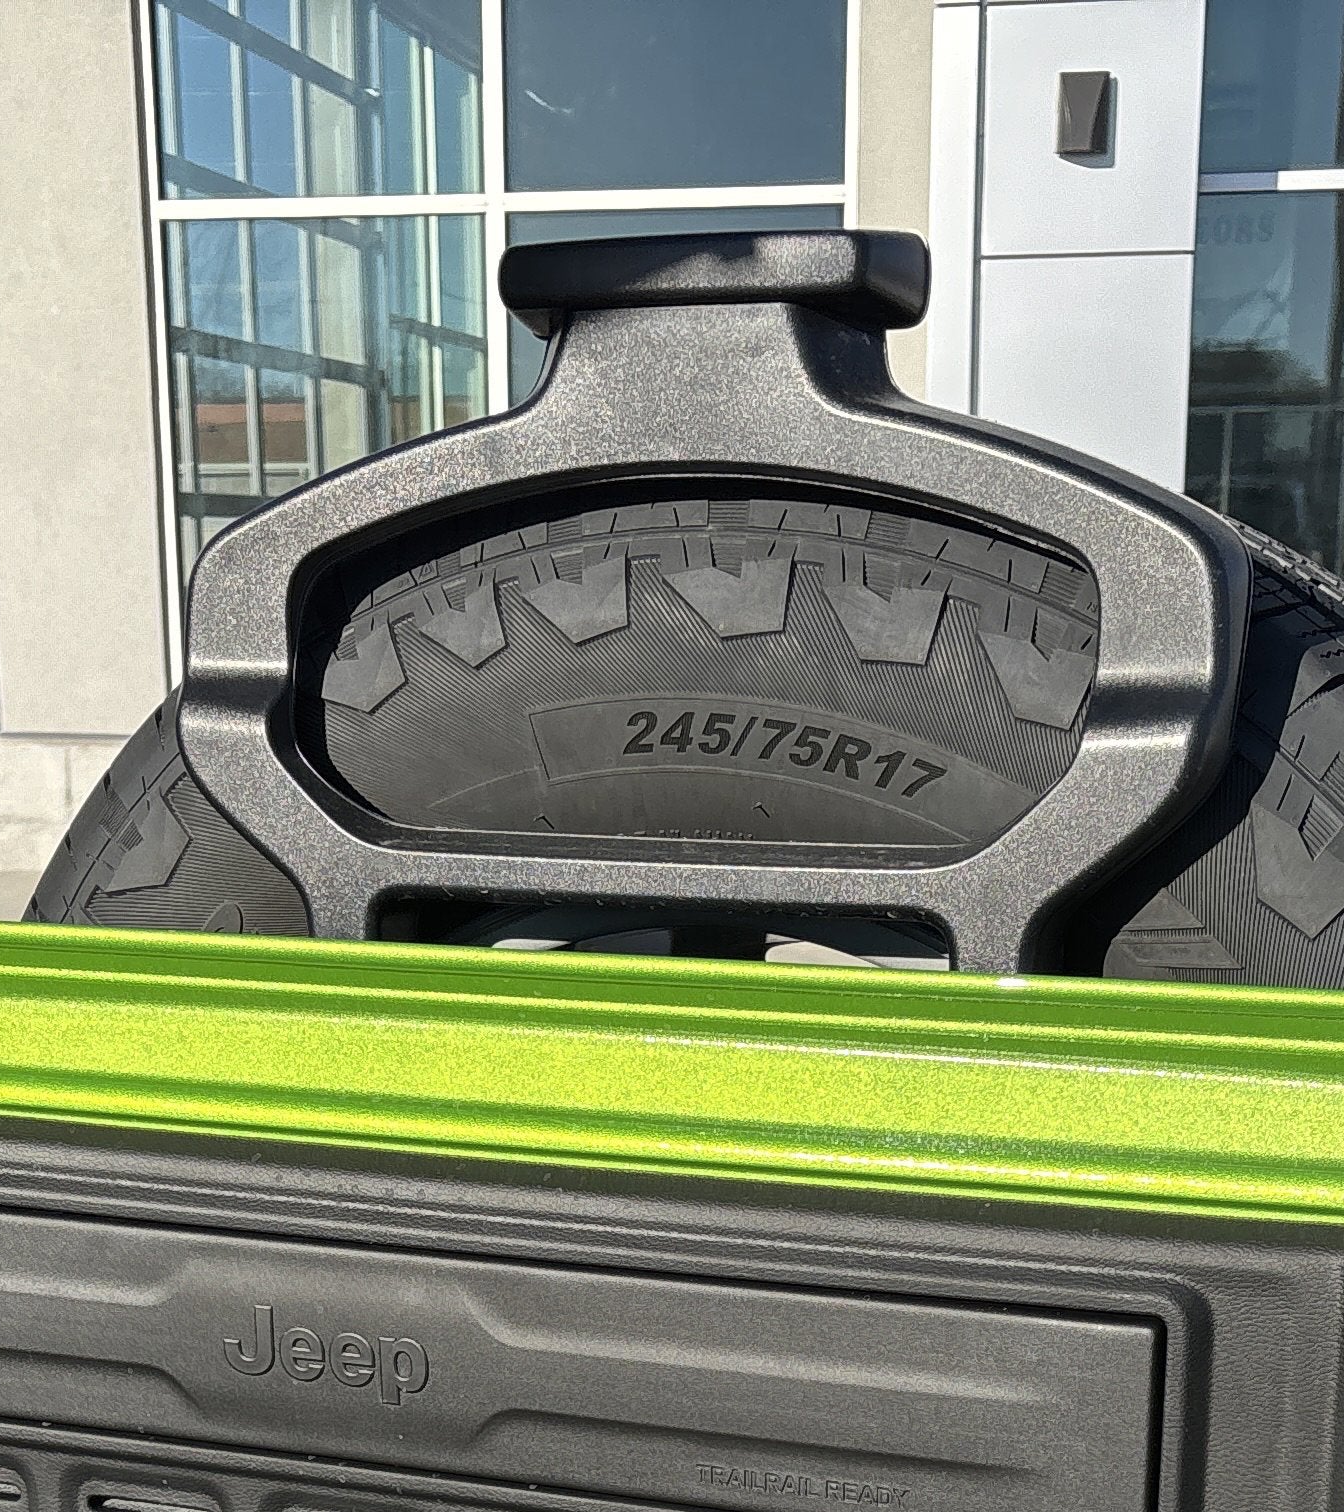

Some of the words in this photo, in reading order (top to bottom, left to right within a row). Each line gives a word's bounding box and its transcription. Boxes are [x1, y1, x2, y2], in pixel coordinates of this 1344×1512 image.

[622, 711, 948, 799] 245/75R17
[222, 1303, 430, 1406] Jeep
[695, 1463, 819, 1499] TRAILRAIL
[824, 1479, 911, 1508] READY
